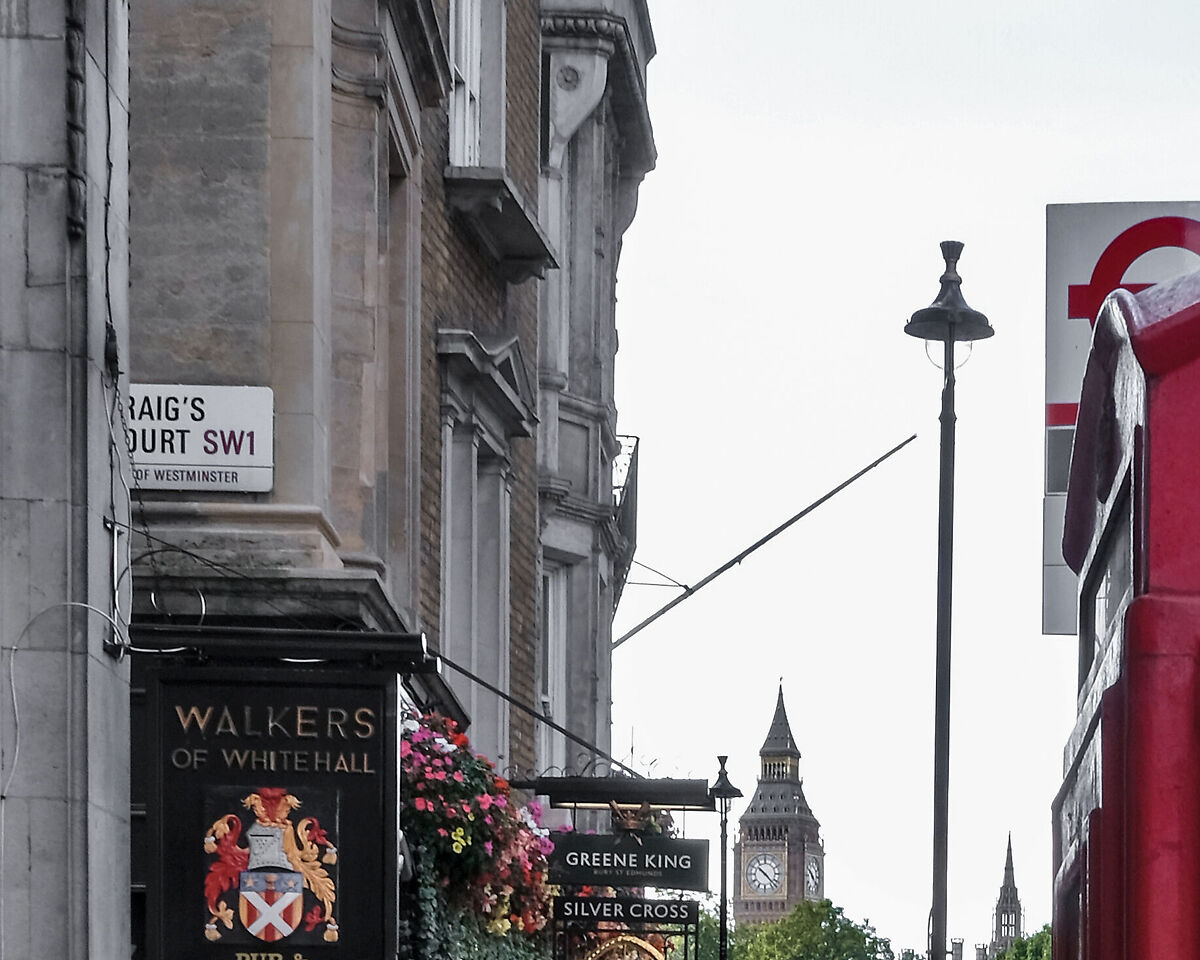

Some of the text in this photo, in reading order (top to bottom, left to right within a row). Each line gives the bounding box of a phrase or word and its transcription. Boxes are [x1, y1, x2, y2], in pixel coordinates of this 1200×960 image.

[203, 429, 255, 456] SW1
[136, 469, 239, 483] OF WESTMINSTER
[175, 705, 376, 739] WALKERS
[172, 748, 376, 774] OF WHITEHALL
[566, 852, 692, 869] GREENE KING
[564, 902, 689, 919] SILVER CROSS
